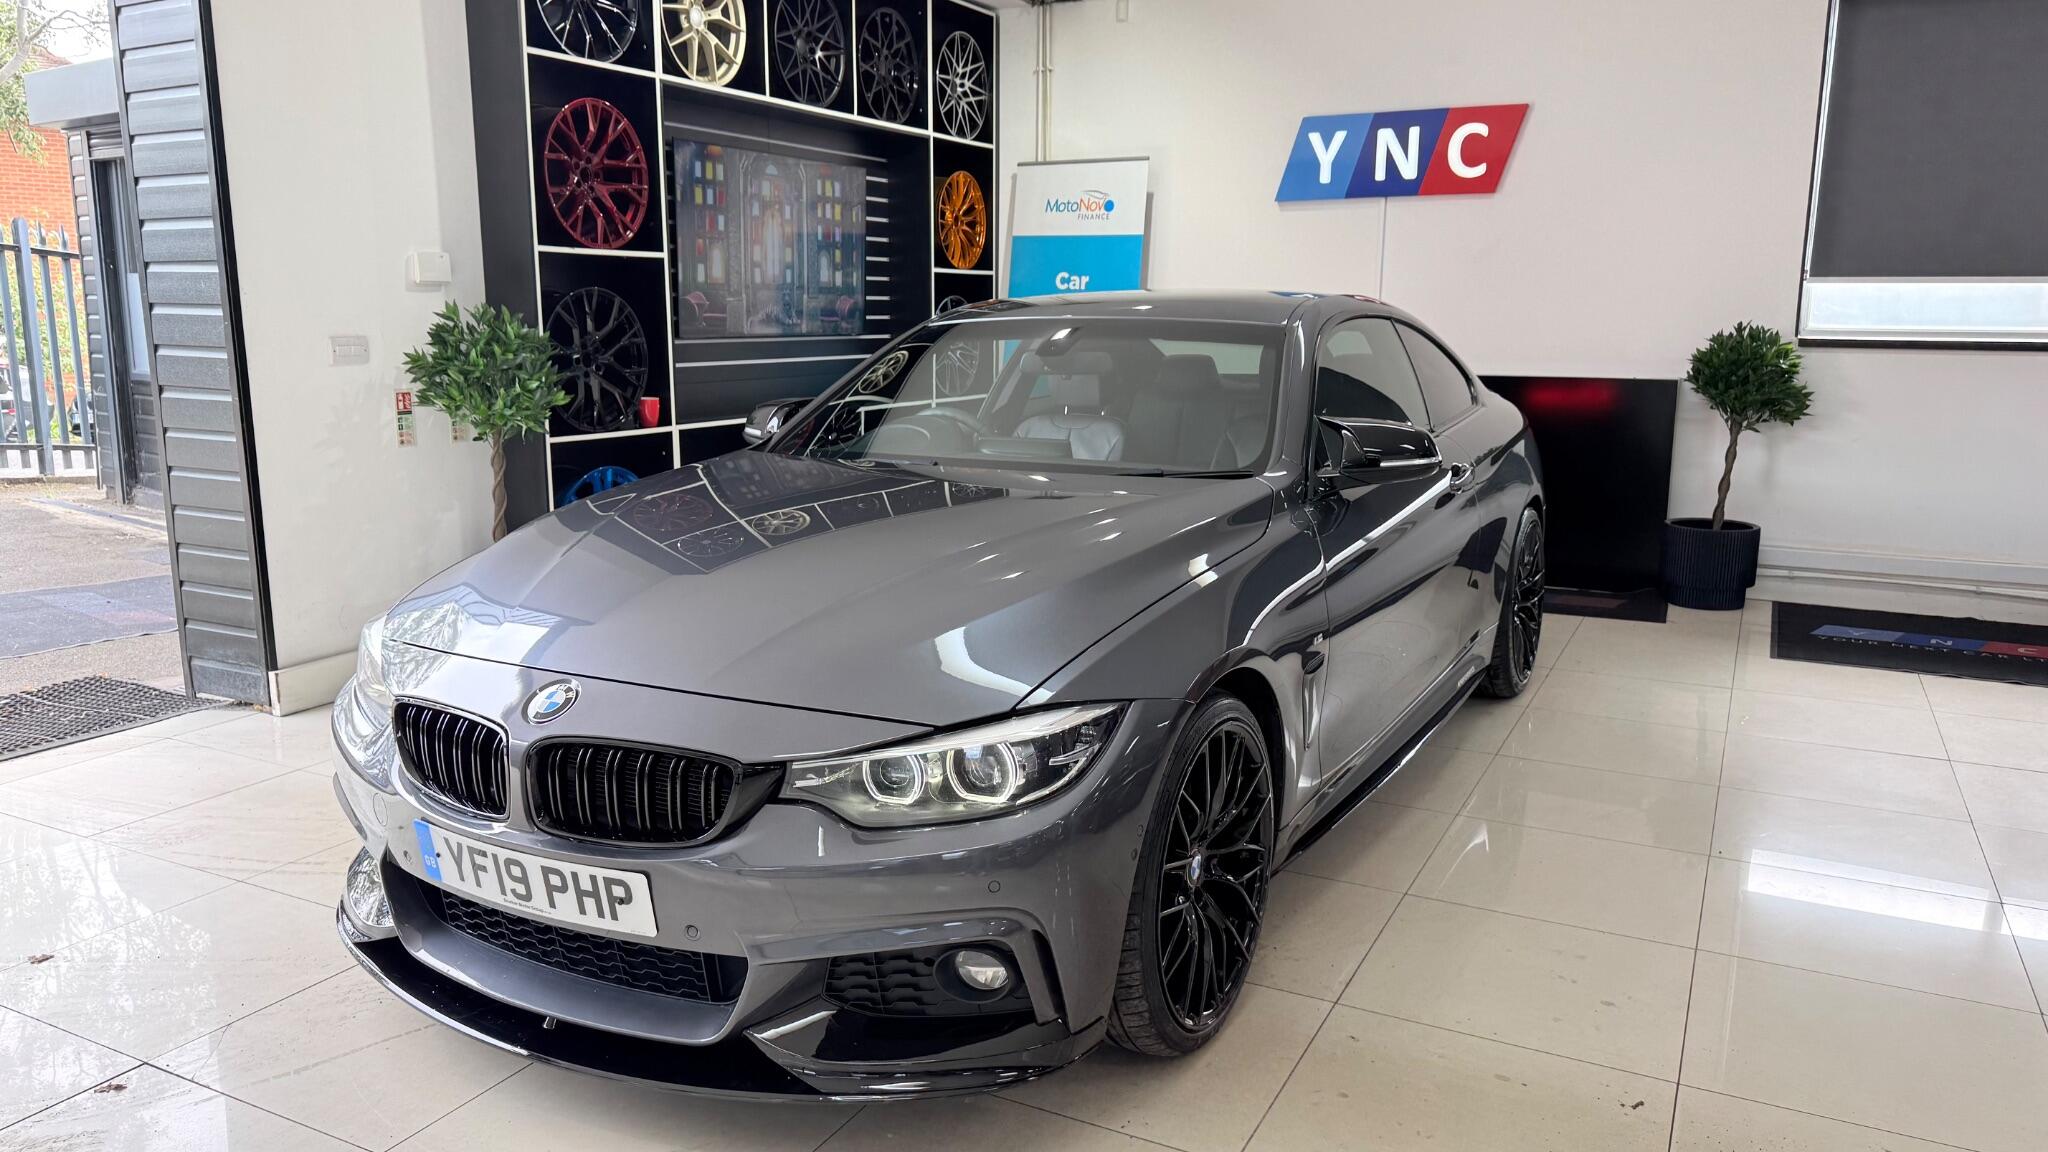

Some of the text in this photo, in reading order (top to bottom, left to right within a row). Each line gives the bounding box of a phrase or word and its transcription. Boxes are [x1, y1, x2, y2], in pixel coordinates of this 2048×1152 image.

[1308, 122, 1489, 184] YNC
[1077, 213, 1110, 221] FINANCE
[1055, 271, 1089, 290] Car
[424, 854, 437, 868] GB
[443, 837, 634, 922] YF19 PHP
